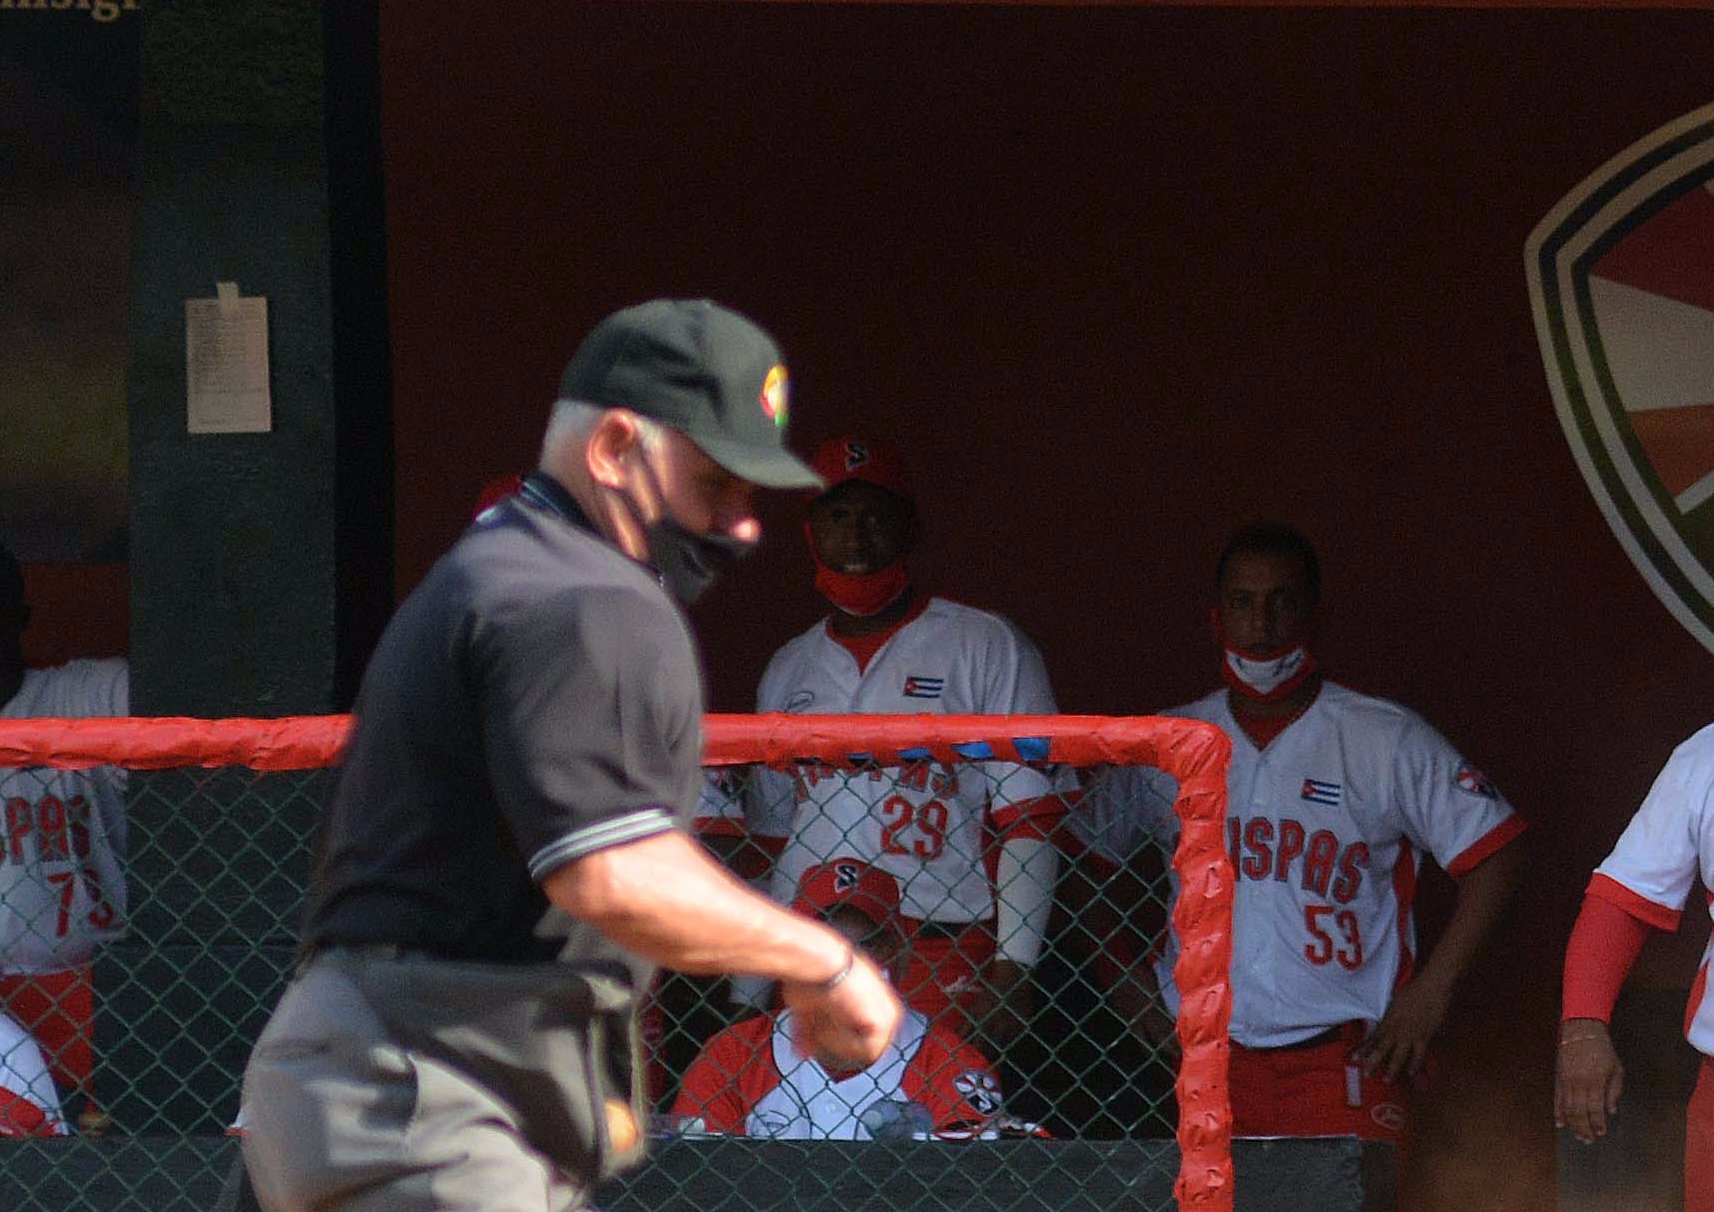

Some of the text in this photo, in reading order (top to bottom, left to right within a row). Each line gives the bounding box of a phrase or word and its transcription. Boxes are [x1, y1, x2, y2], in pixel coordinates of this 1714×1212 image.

[881, 795, 949, 860] 29
[835, 863, 858, 893] S
[1303, 904, 1364, 971] 53
